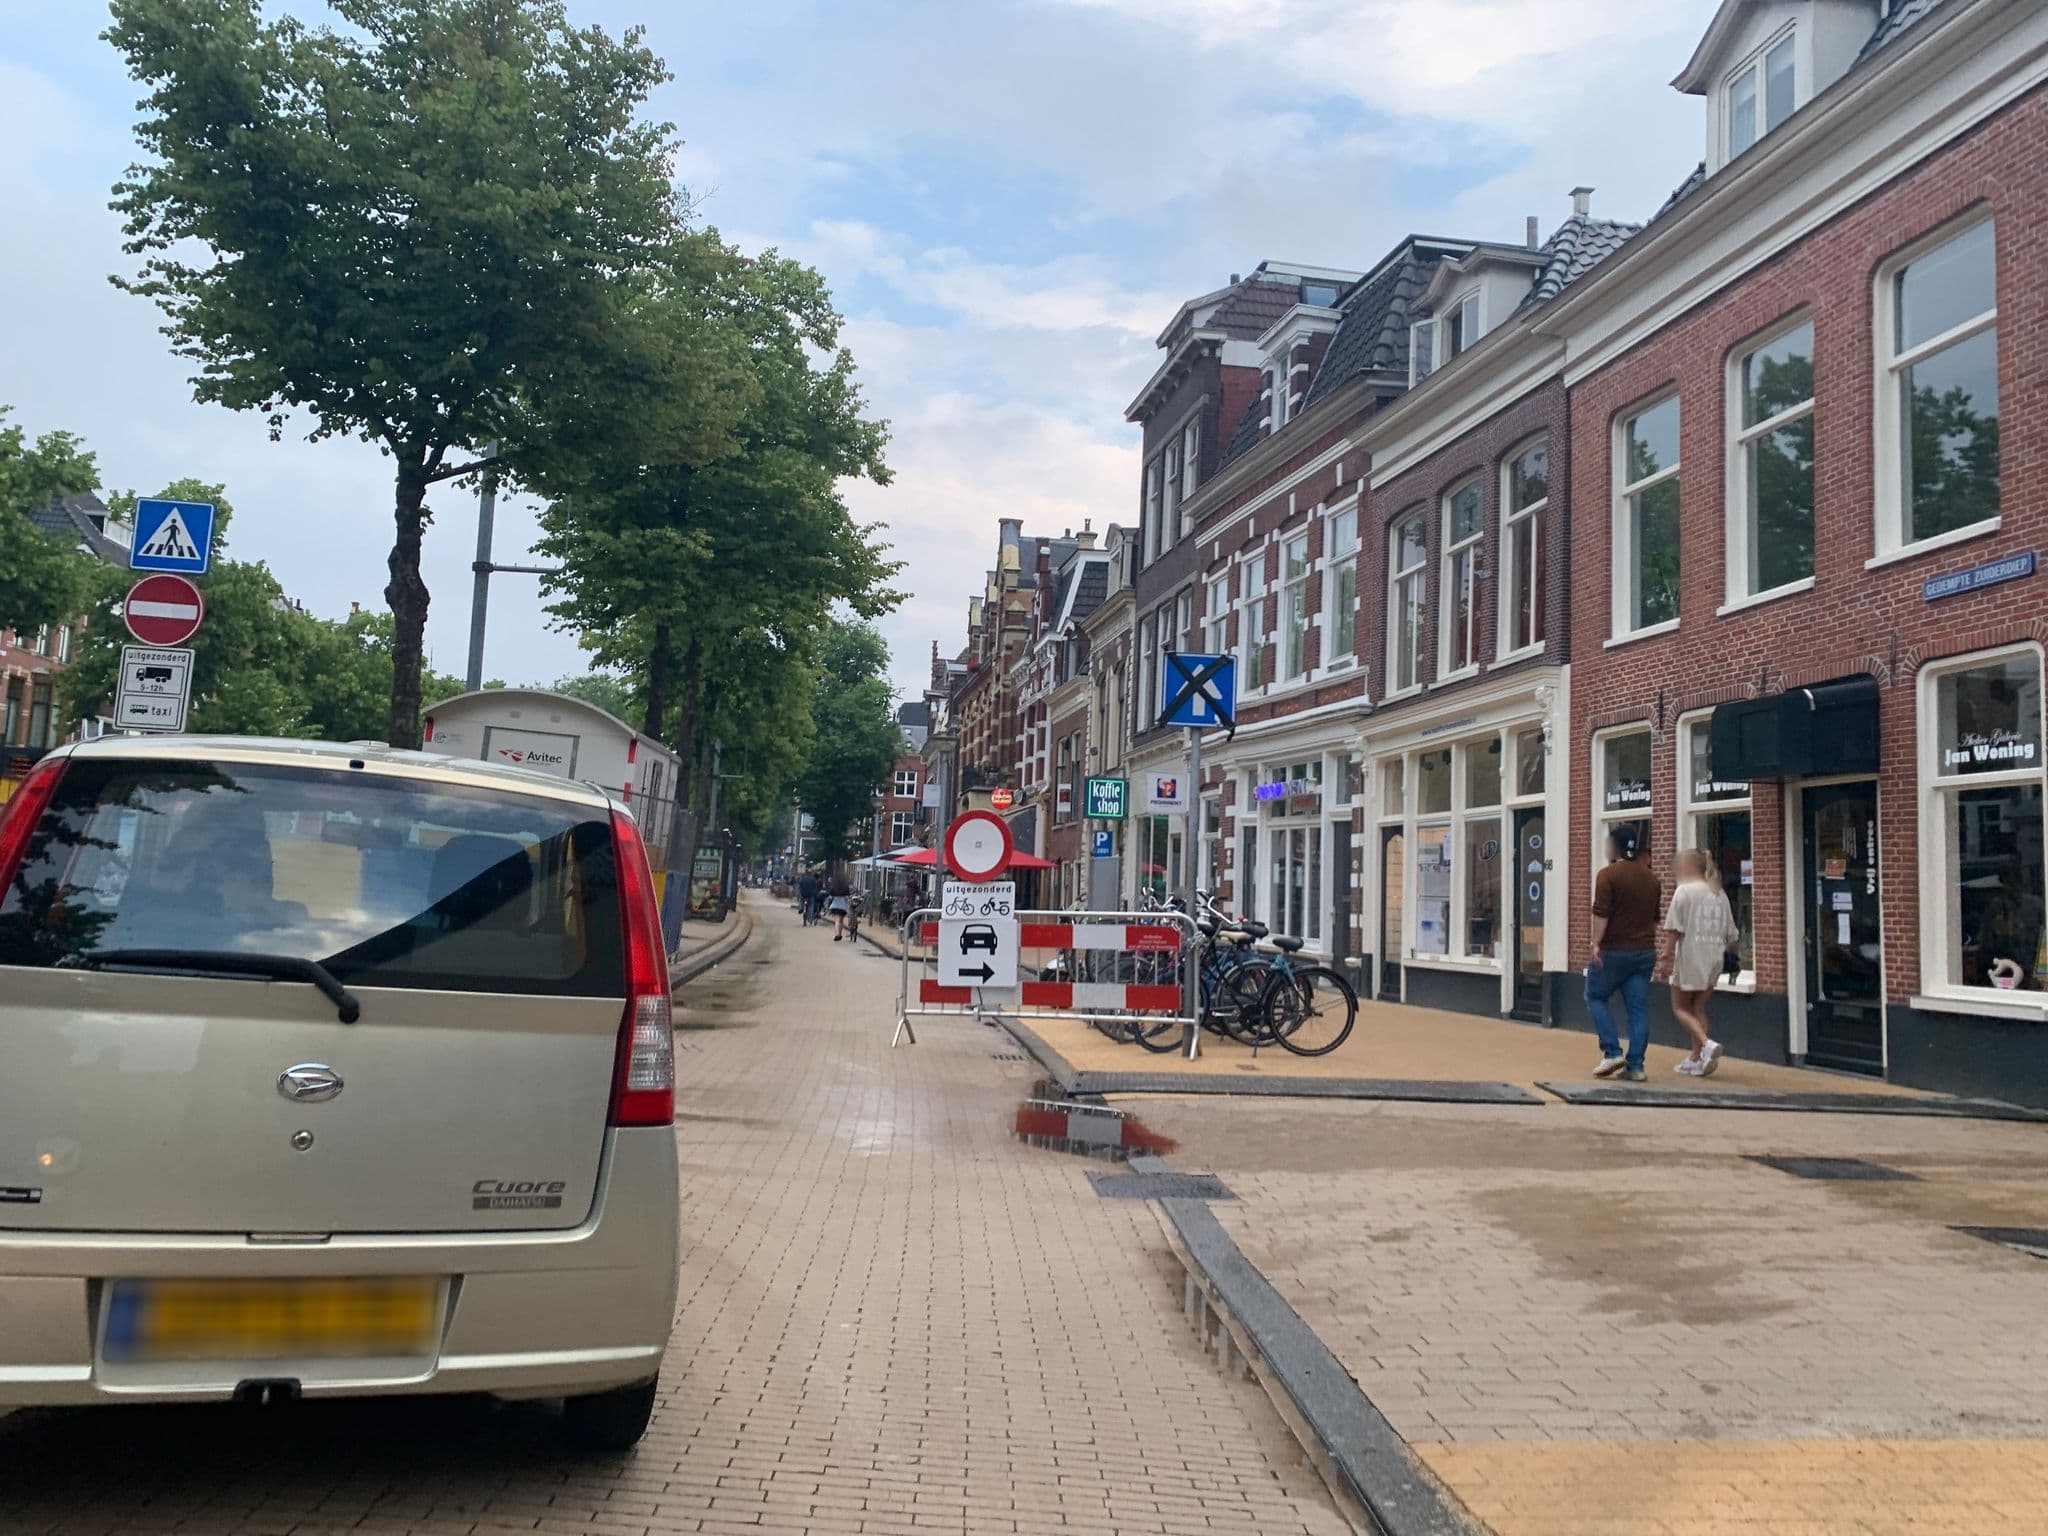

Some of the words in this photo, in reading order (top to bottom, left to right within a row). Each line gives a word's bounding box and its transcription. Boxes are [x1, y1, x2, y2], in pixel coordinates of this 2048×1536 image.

[1926, 573, 1971, 596] GEDEMPTE
[1975, 557, 2028, 581] ZUIDERDIEP
[127, 652, 187, 663] uitgezonderd
[151, 706, 172, 717] taxi
[526, 751, 562, 764] Avitec
[1944, 748, 1970, 767] Jan
[1973, 741, 2034, 760] Woning
[1696, 781, 1710, 796] Jan
[1607, 792, 1620, 804] Jan
[1620, 788, 1651, 802] Woning
[1097, 798, 1119, 814] shop
[946, 885, 1012, 895] uitgezonderd
[472, 1180, 566, 1194] Cuore
[489, 1196, 546, 1209] DAIHATSU
